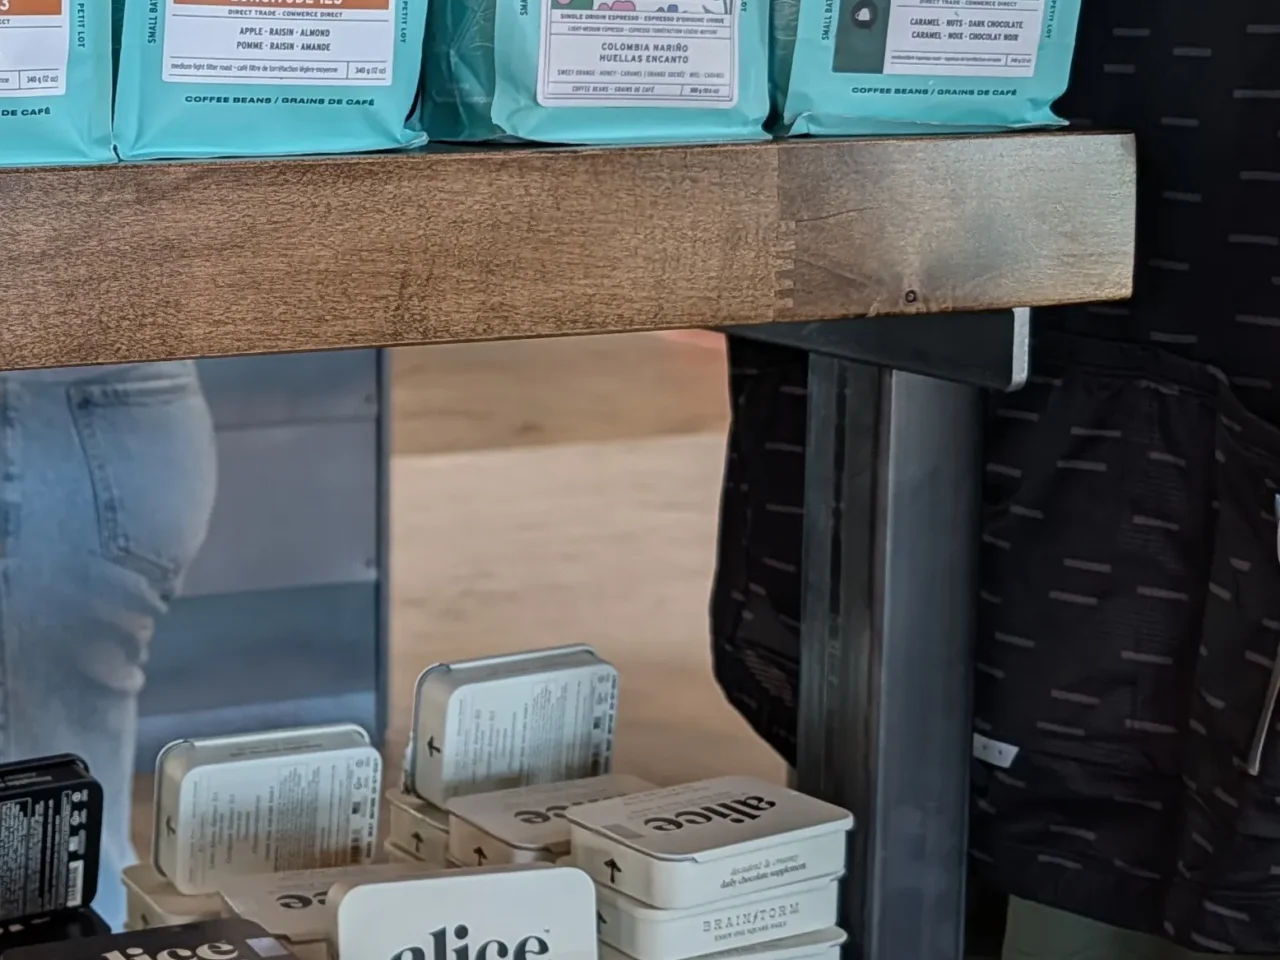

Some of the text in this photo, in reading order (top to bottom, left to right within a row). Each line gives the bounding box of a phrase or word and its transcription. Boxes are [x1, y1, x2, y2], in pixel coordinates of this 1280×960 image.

[78, 3, 86, 48] PETIT LOT
[910, 18, 1024, 29] CARAMEL NUTS DARK CHOCOLATE
[148, 16, 158, 44] SMALL
[239, 27, 330, 37] APPLE RAISIN ALMOND
[912, 31, 1002, 41] CARAMEL CHOCOLAT
[236, 41, 331, 52] POMME RAISIN AMANDE
[602, 43, 688, 52] COLOMBIA NARIÑO
[599, 54, 689, 64] HUELLAS ENCANTO
[851, 87, 892, 95] COFFEE
[894, 88, 928, 96] BEANS
[185, 95, 230, 103] COFFEE
[233, 96, 272, 104] BEANS
[346, 98, 375, 106] CAFÉ
[21, 107, 51, 116] CAFÉ
[644, 796, 777, 832] alice
[720, 862, 806, 889] daily chocolate supplement
